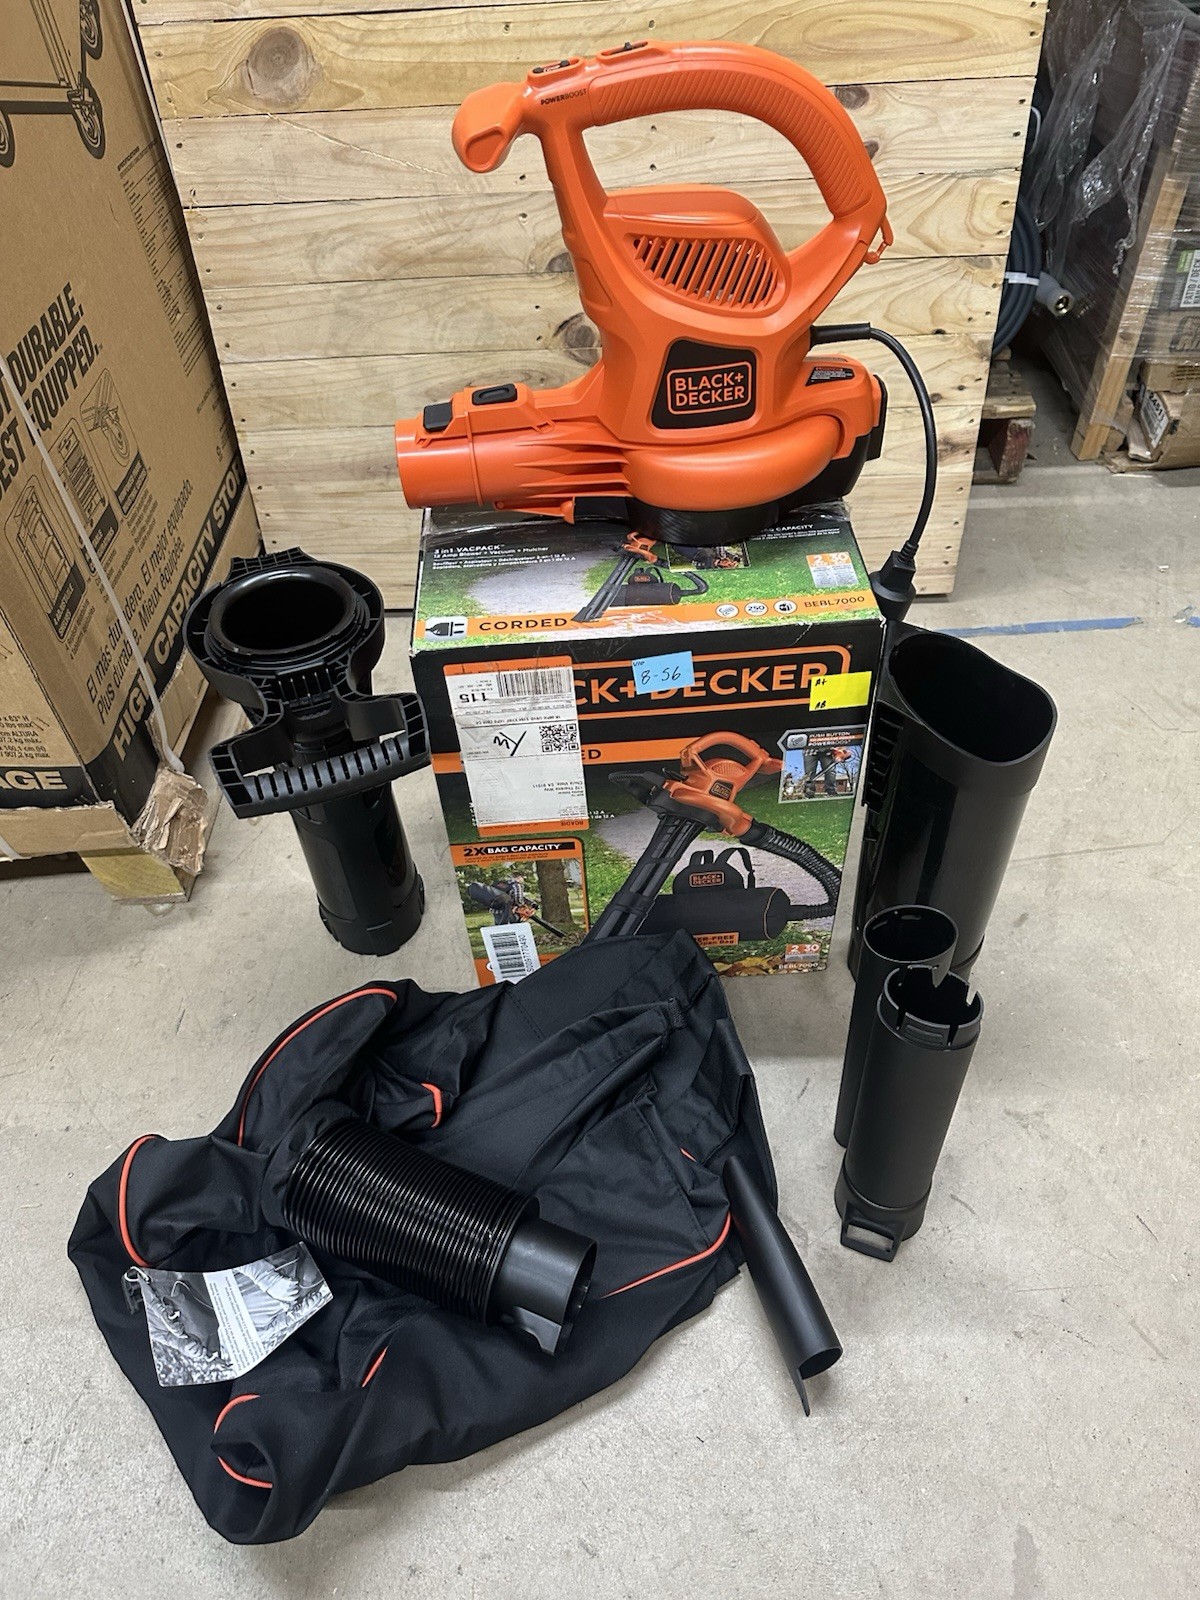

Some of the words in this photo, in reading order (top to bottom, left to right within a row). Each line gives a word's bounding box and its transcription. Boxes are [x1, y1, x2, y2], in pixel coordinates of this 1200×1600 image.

[541, 88, 587, 106] POWERBOOST
[6, 281, 84, 396] DURABLE.
[675, 371, 745, 392] BLACK+
[675, 386, 745, 407] DECKER
[775, 523, 813, 533] CAPACITY
[149, 527, 169, 573] mejor
[154, 518, 216, 665] CAPACITY
[804, 596, 865, 608] BEBL7000
[479, 618, 567, 631] CORDED
[96, 683, 116, 726] Plus
[138, 582, 163, 632] Mieux
[459, 692, 488, 704] 115
[487, 846, 509, 854] BAG
[510, 844, 561, 852] CAPACITY
